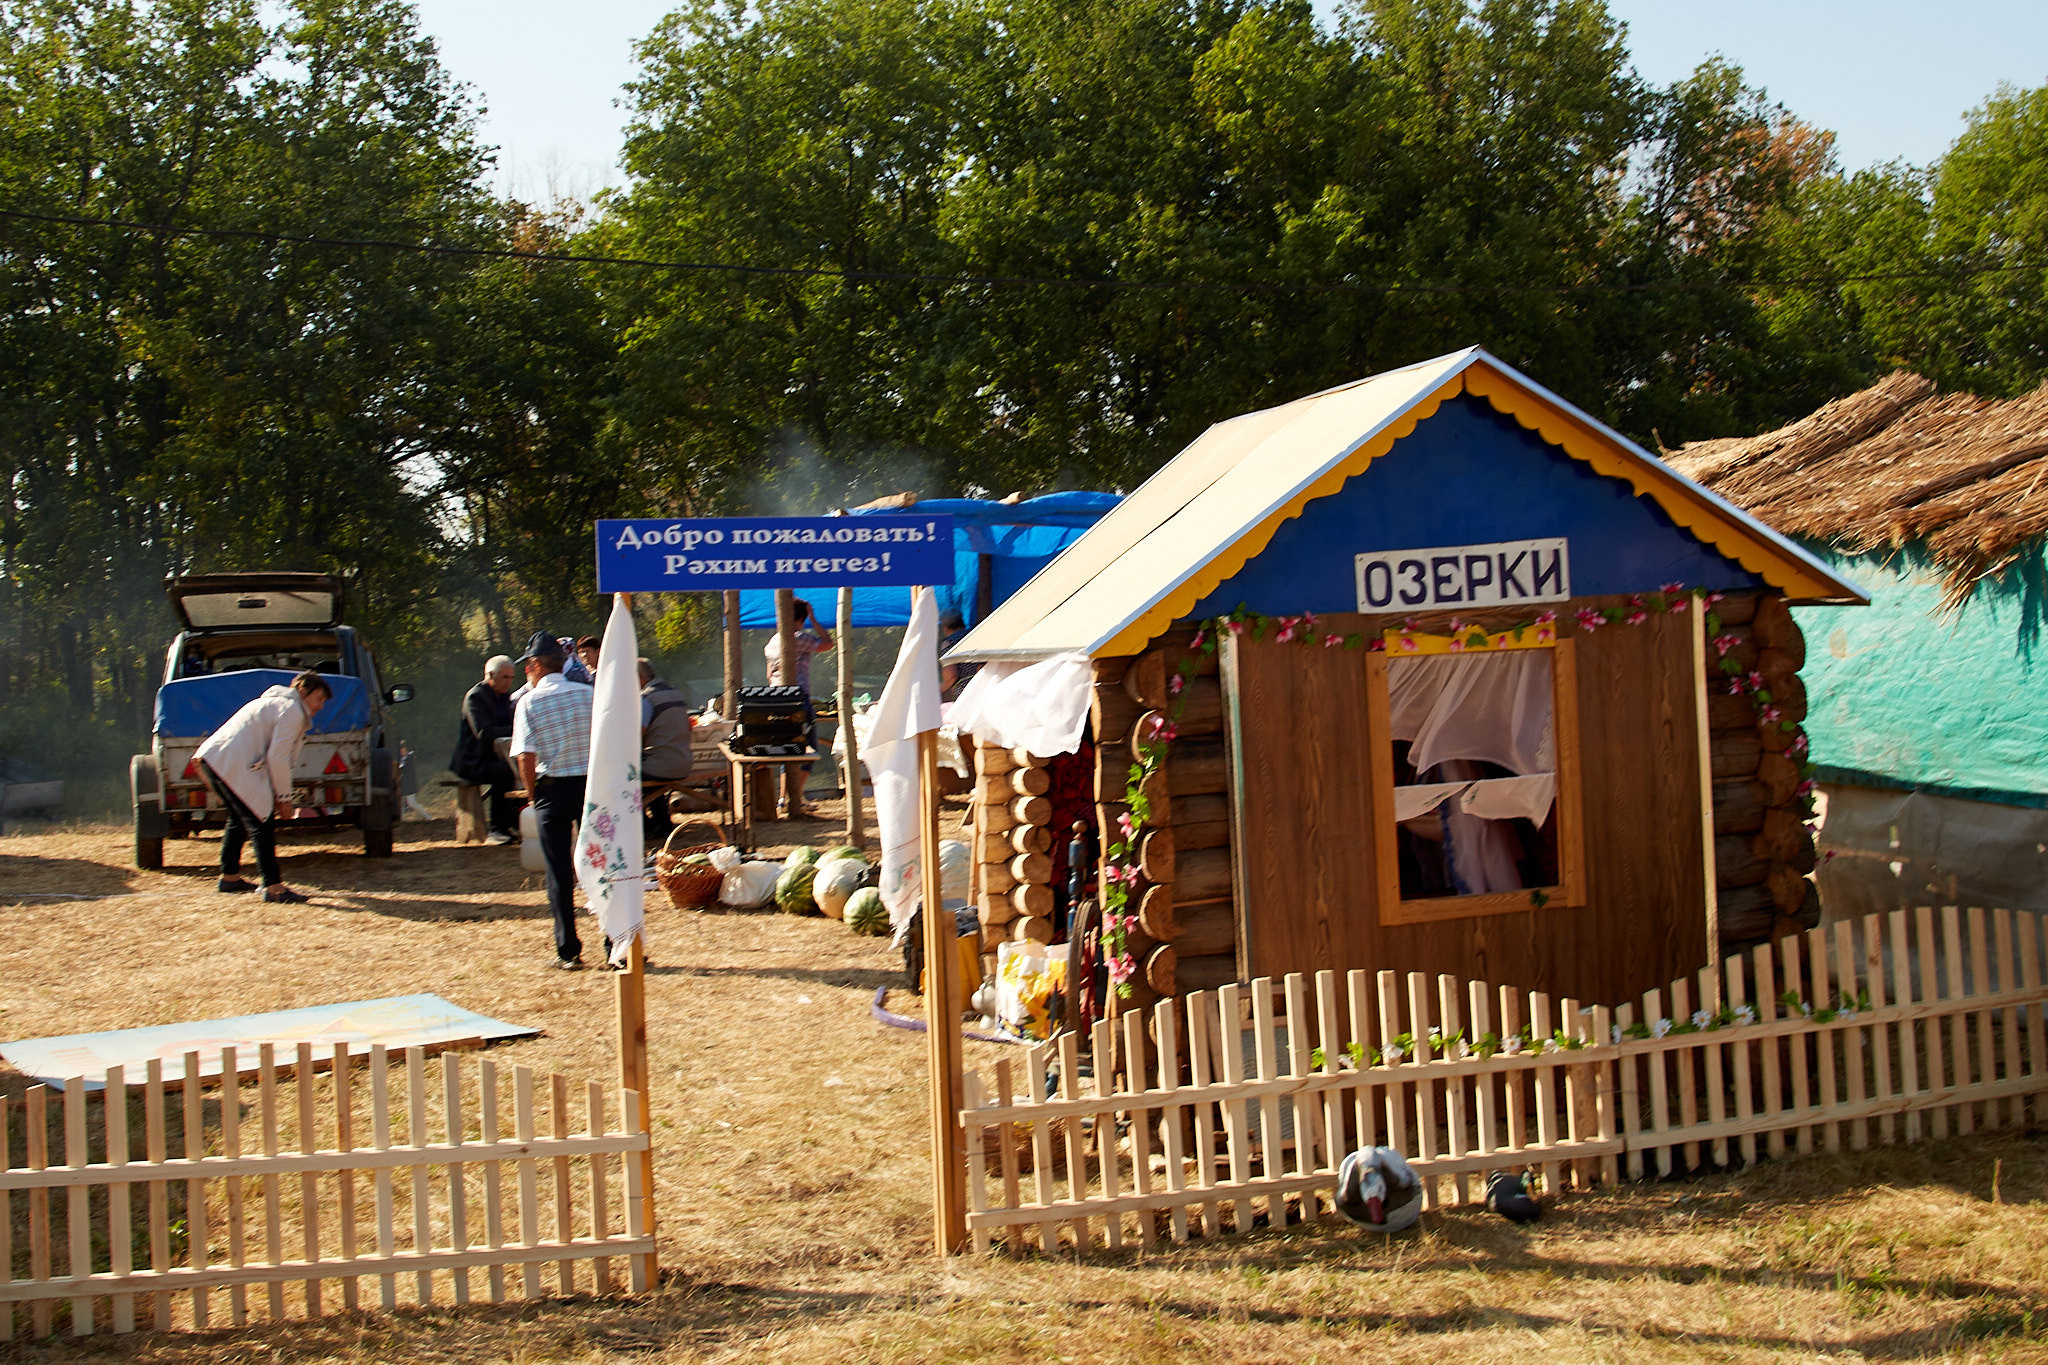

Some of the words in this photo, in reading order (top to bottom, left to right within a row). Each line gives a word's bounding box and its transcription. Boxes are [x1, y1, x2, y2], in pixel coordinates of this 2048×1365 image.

[615, 524, 724, 550] Добро
[731, 522, 937, 545] пожаловать!
[663, 554, 767, 576] Рәхим
[774, 552, 892, 574] итегез!
[1364, 548, 1562, 607] ОЗЕРКИ
